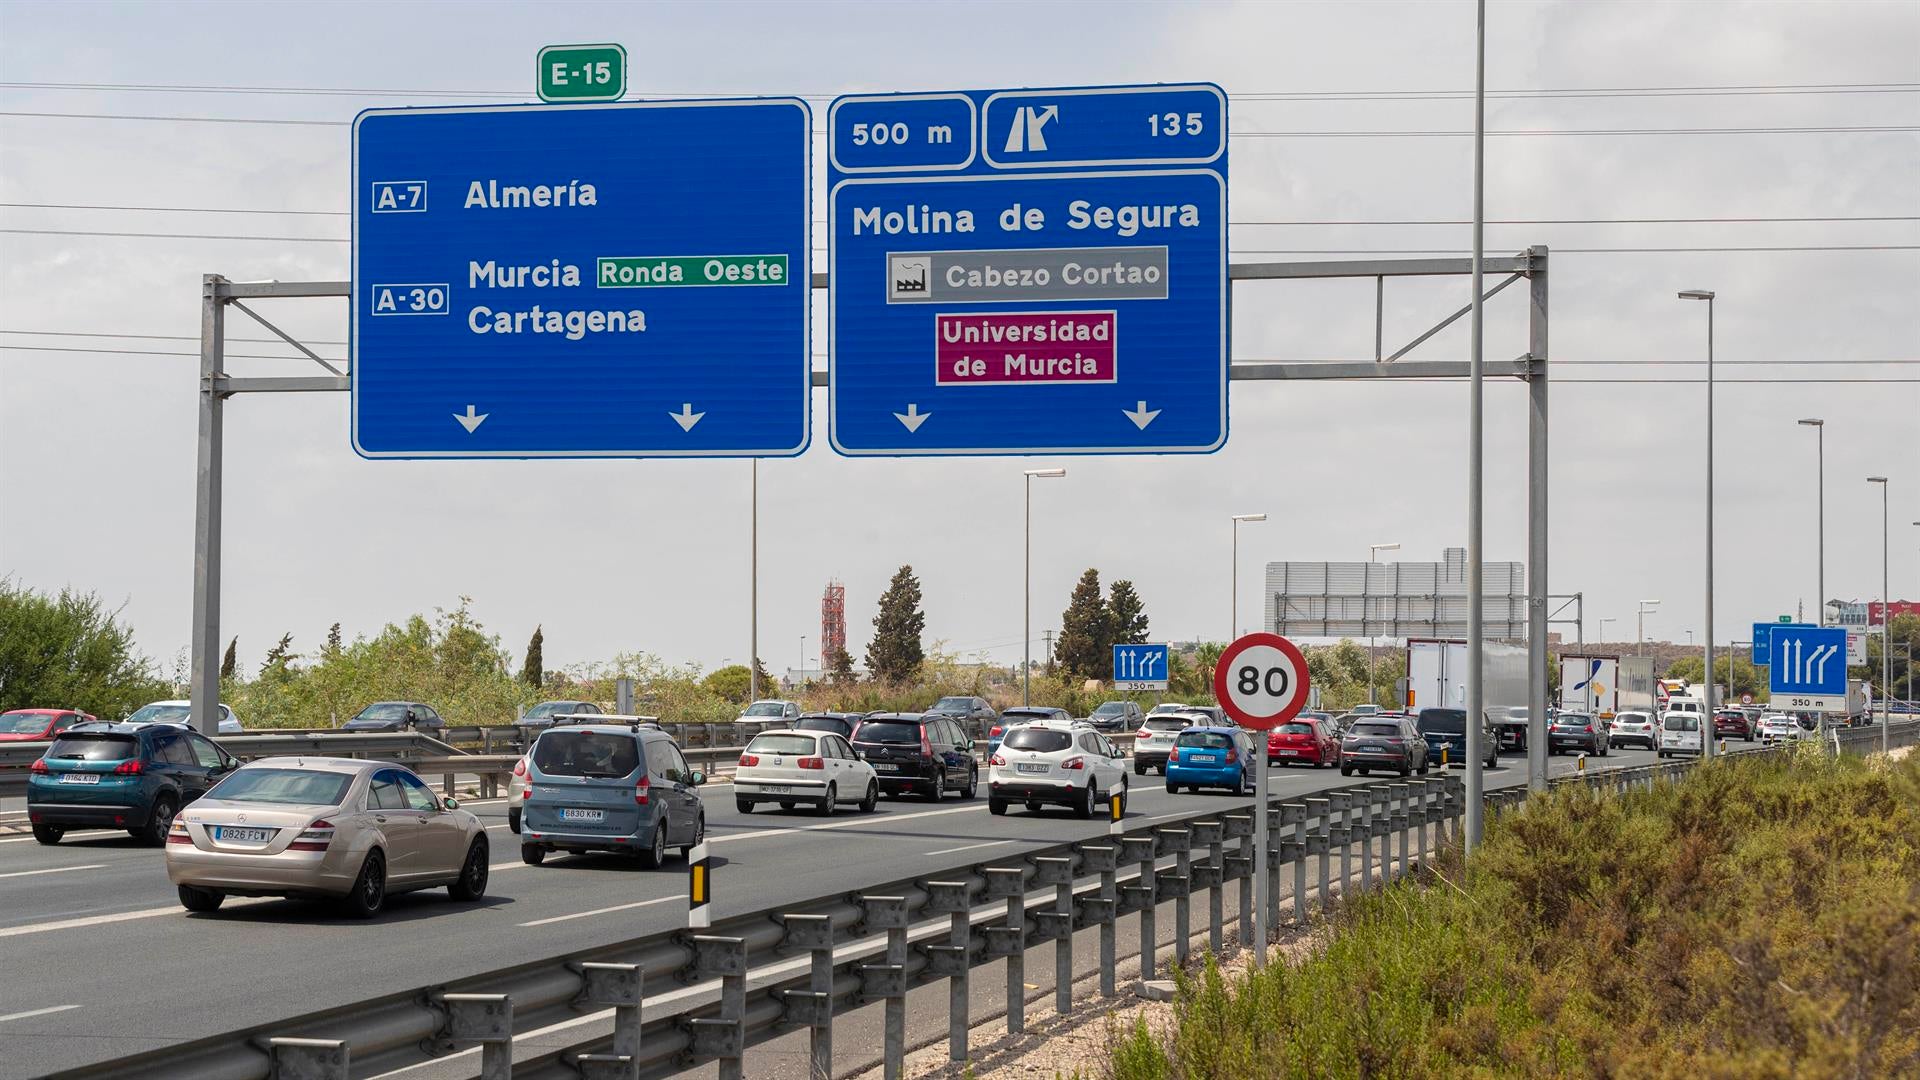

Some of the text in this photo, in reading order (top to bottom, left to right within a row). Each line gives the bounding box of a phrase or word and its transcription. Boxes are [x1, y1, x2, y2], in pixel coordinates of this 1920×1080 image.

[552, 62, 611, 85] E-15
[852, 123, 952, 146] 500 m
[1148, 112, 1203, 137] 135
[377, 186, 422, 208] A-7
[464, 179, 598, 209] Almería
[853, 200, 1200, 237] Molina de Segura
[469, 258, 784, 289] Murcia Ronda Oeste
[945, 260, 1160, 288] Cabezo Cortao
[376, 288, 444, 311] A-30
[468, 304, 647, 341] Cartagena
[943, 319, 1109, 343] Universidad
[953, 352, 1098, 377] de Murcia
[1128, 682, 1146, 690] 350
[1237, 666, 1289, 697] 80
[1792, 698, 1810, 707] 350
[565, 809, 585, 818] 6830
[222, 828, 246, 840] 0826
